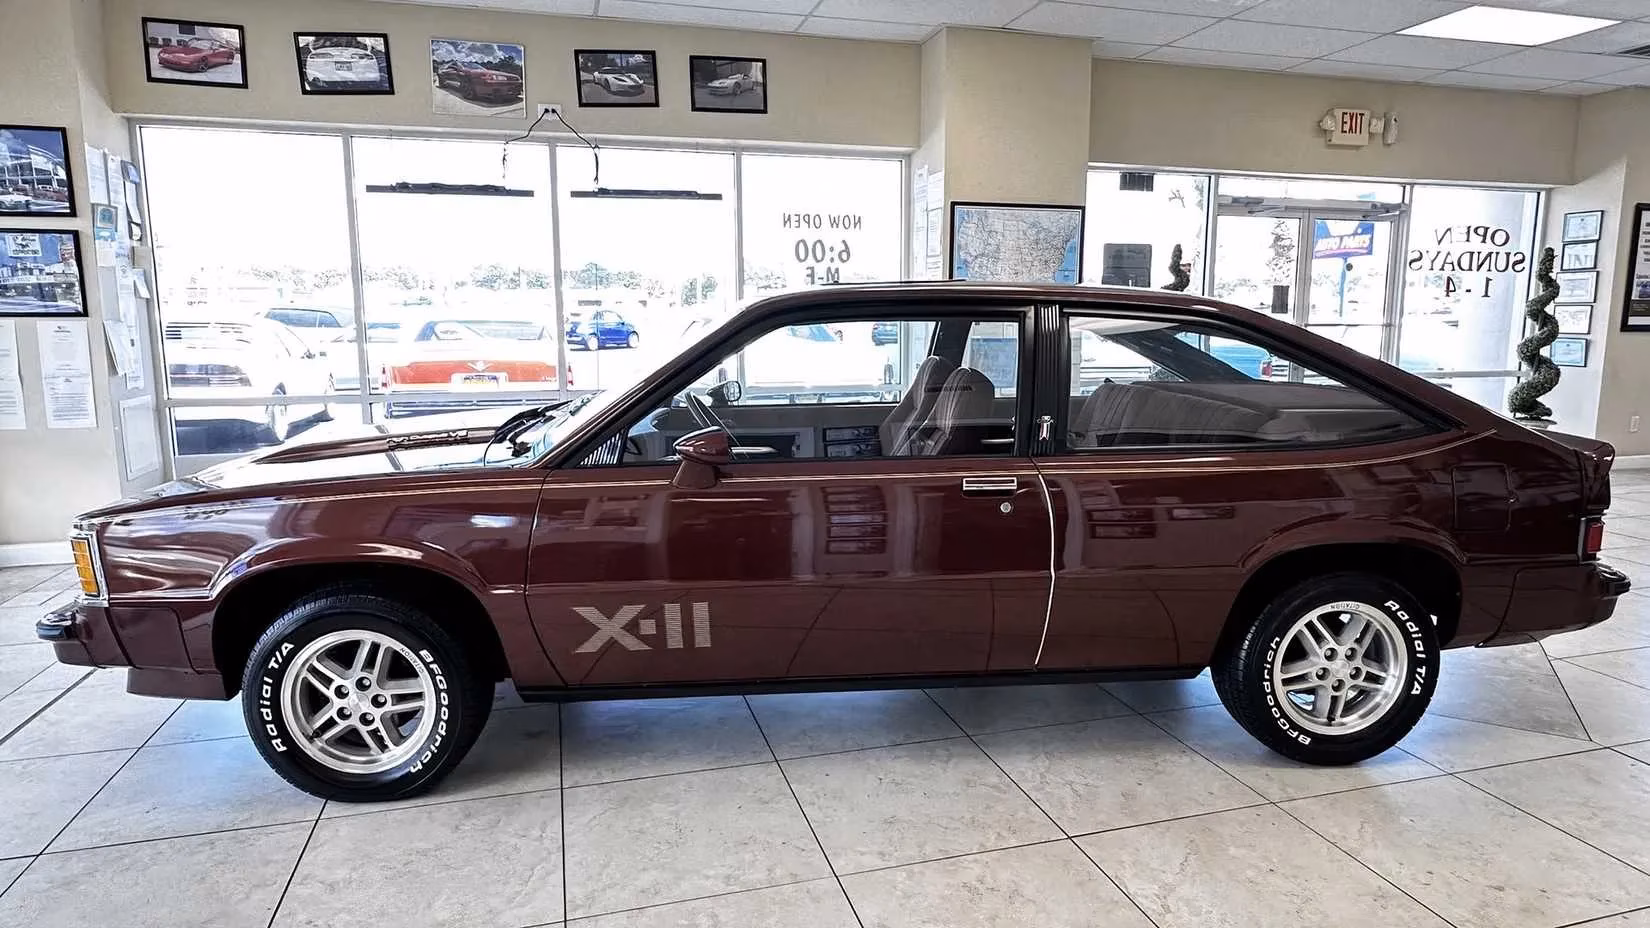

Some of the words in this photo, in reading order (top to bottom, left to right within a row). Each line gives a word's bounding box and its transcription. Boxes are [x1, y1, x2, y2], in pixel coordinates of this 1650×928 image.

[1340, 111, 1365, 135] EXIT
[267, 640, 295, 673] T/A
[1261, 635, 1313, 747] BFGoodrich
[1383, 599, 1426, 659] Radial
[1410, 665, 1427, 697] T/A
[259, 675, 288, 754] Radial
[408, 648, 451, 775] BFGoodrich
